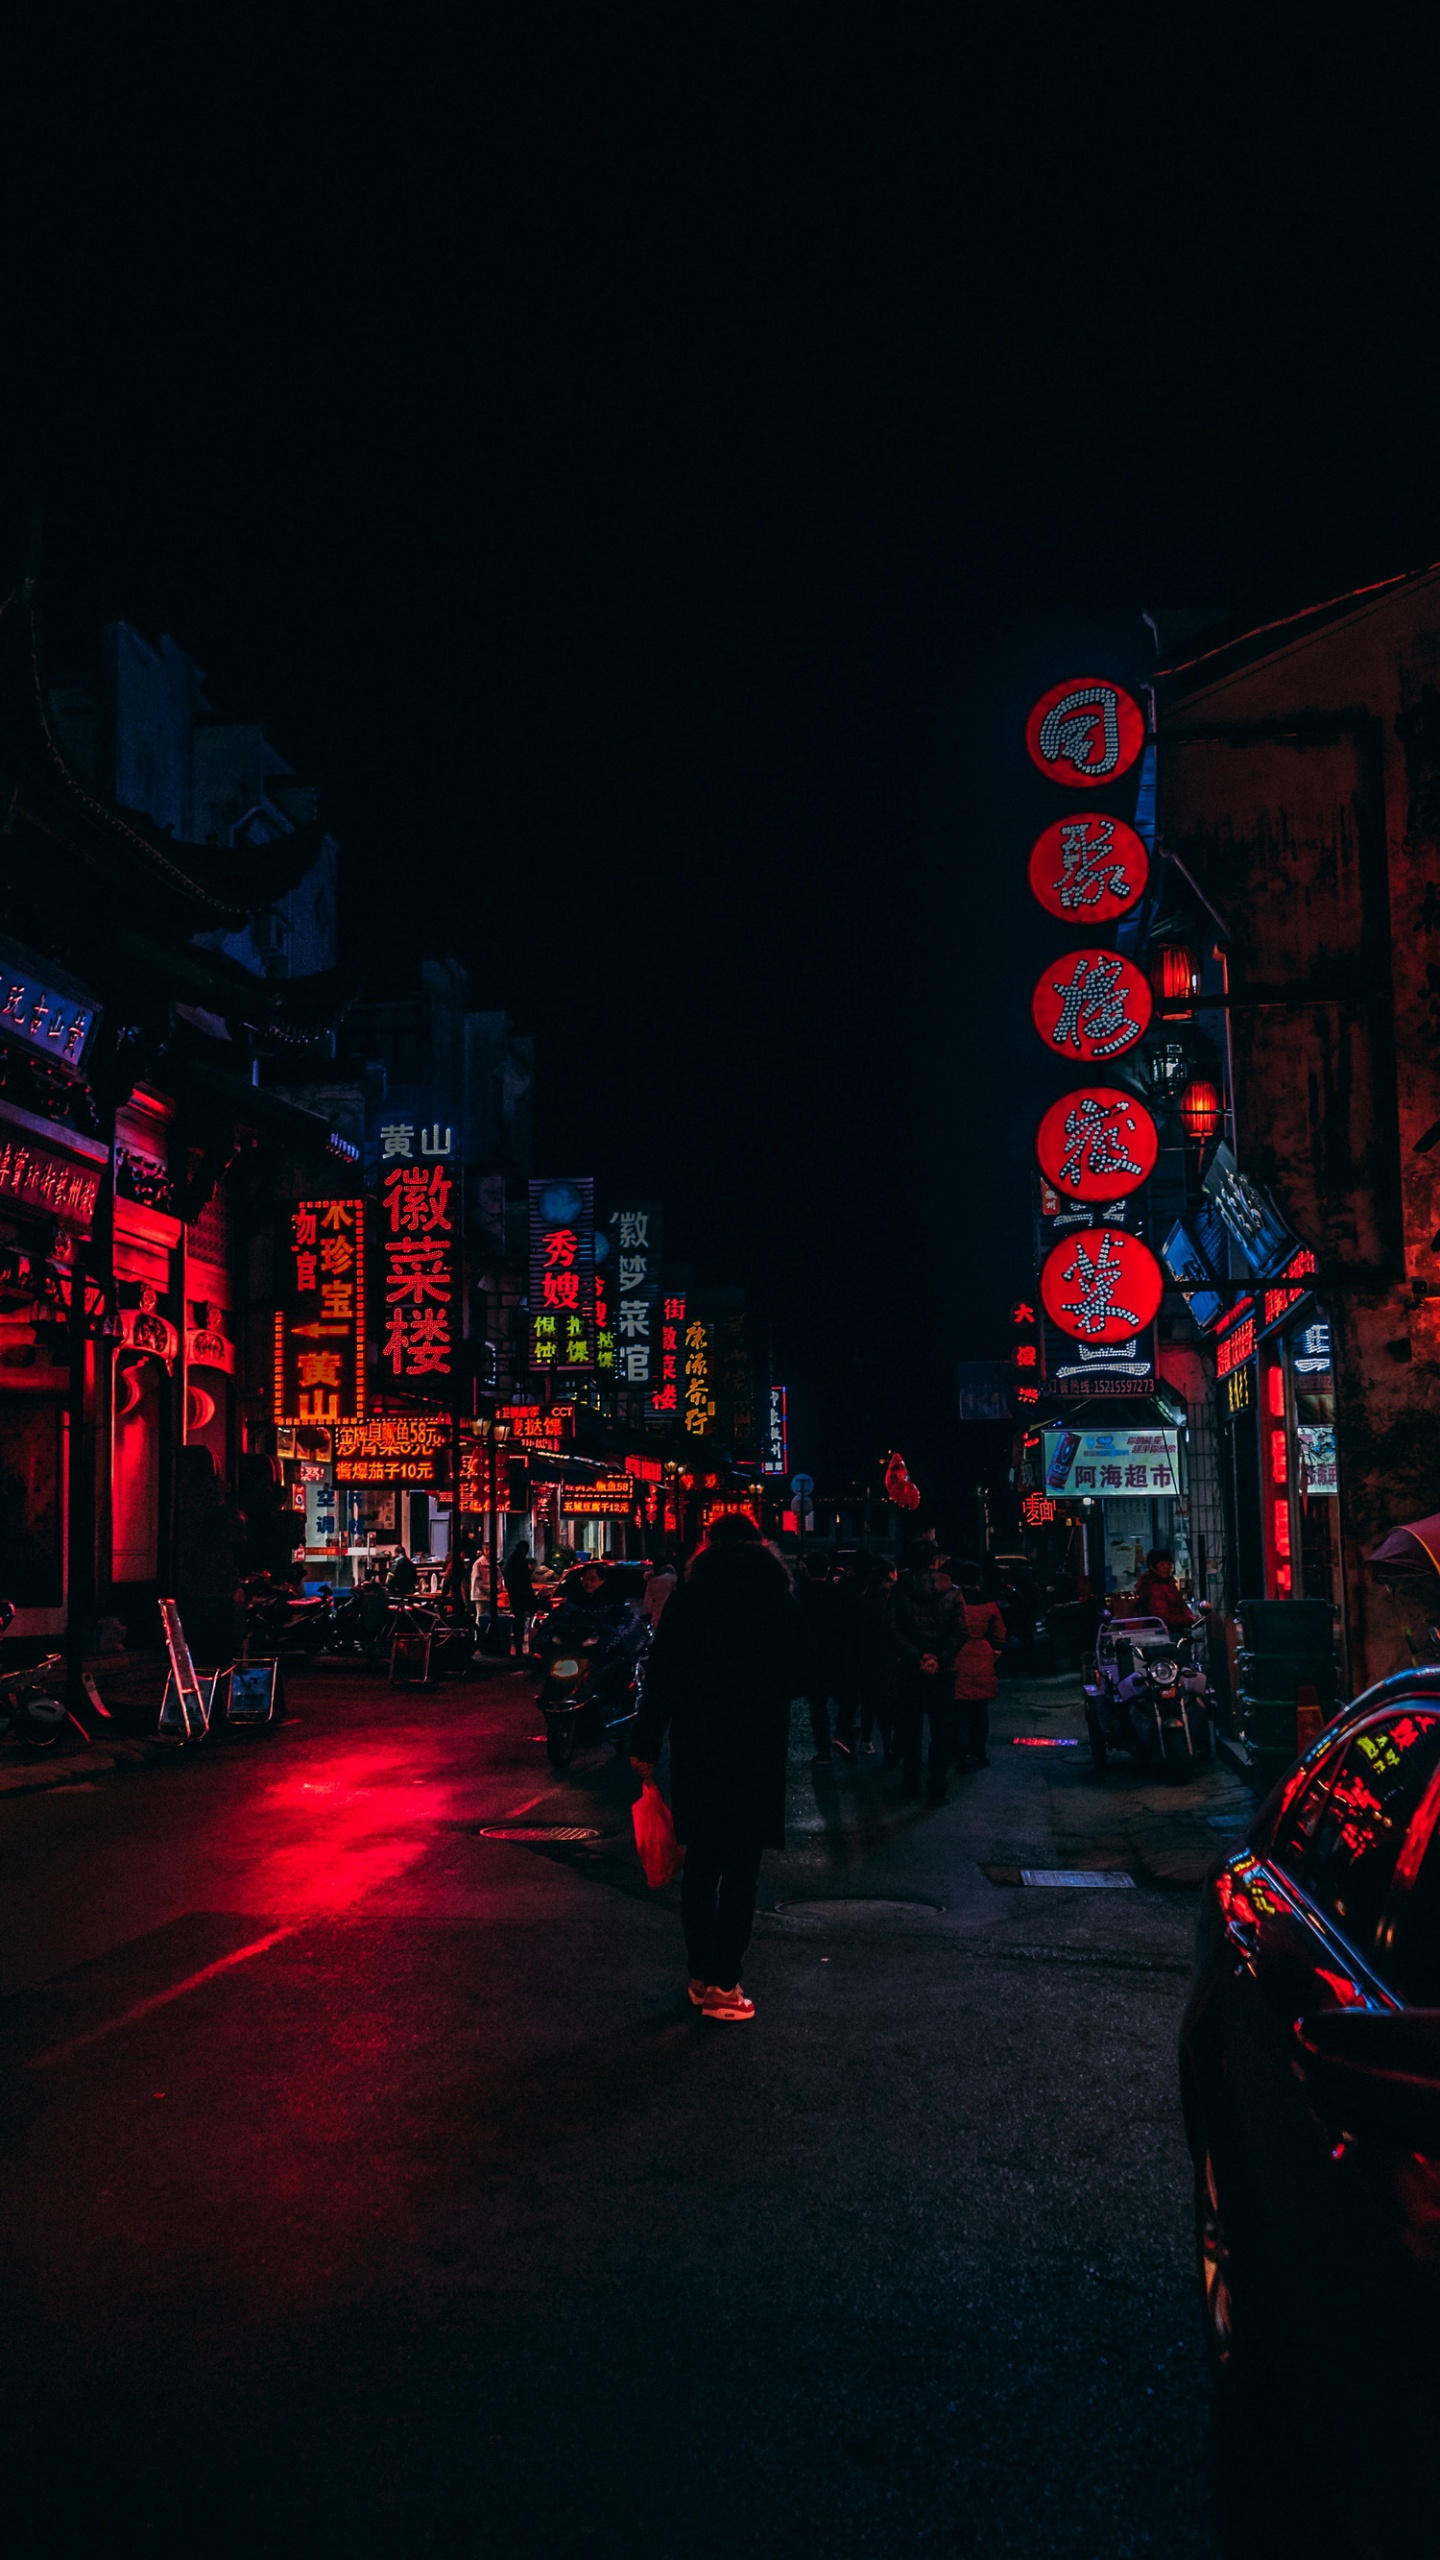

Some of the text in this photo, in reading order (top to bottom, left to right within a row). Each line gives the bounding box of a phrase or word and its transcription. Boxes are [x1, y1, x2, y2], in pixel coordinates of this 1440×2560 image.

[381, 1124, 451, 1159] 黄山
[382, 1165, 453, 1375] 徽菜楼
[541, 1228, 580, 1311] 秀嫂
[297, 1351, 341, 1422] 黄山
[336, 1461, 434, 1480] 酱爆茄子10元
[1075, 1464, 1171, 1489] 阿海超市
